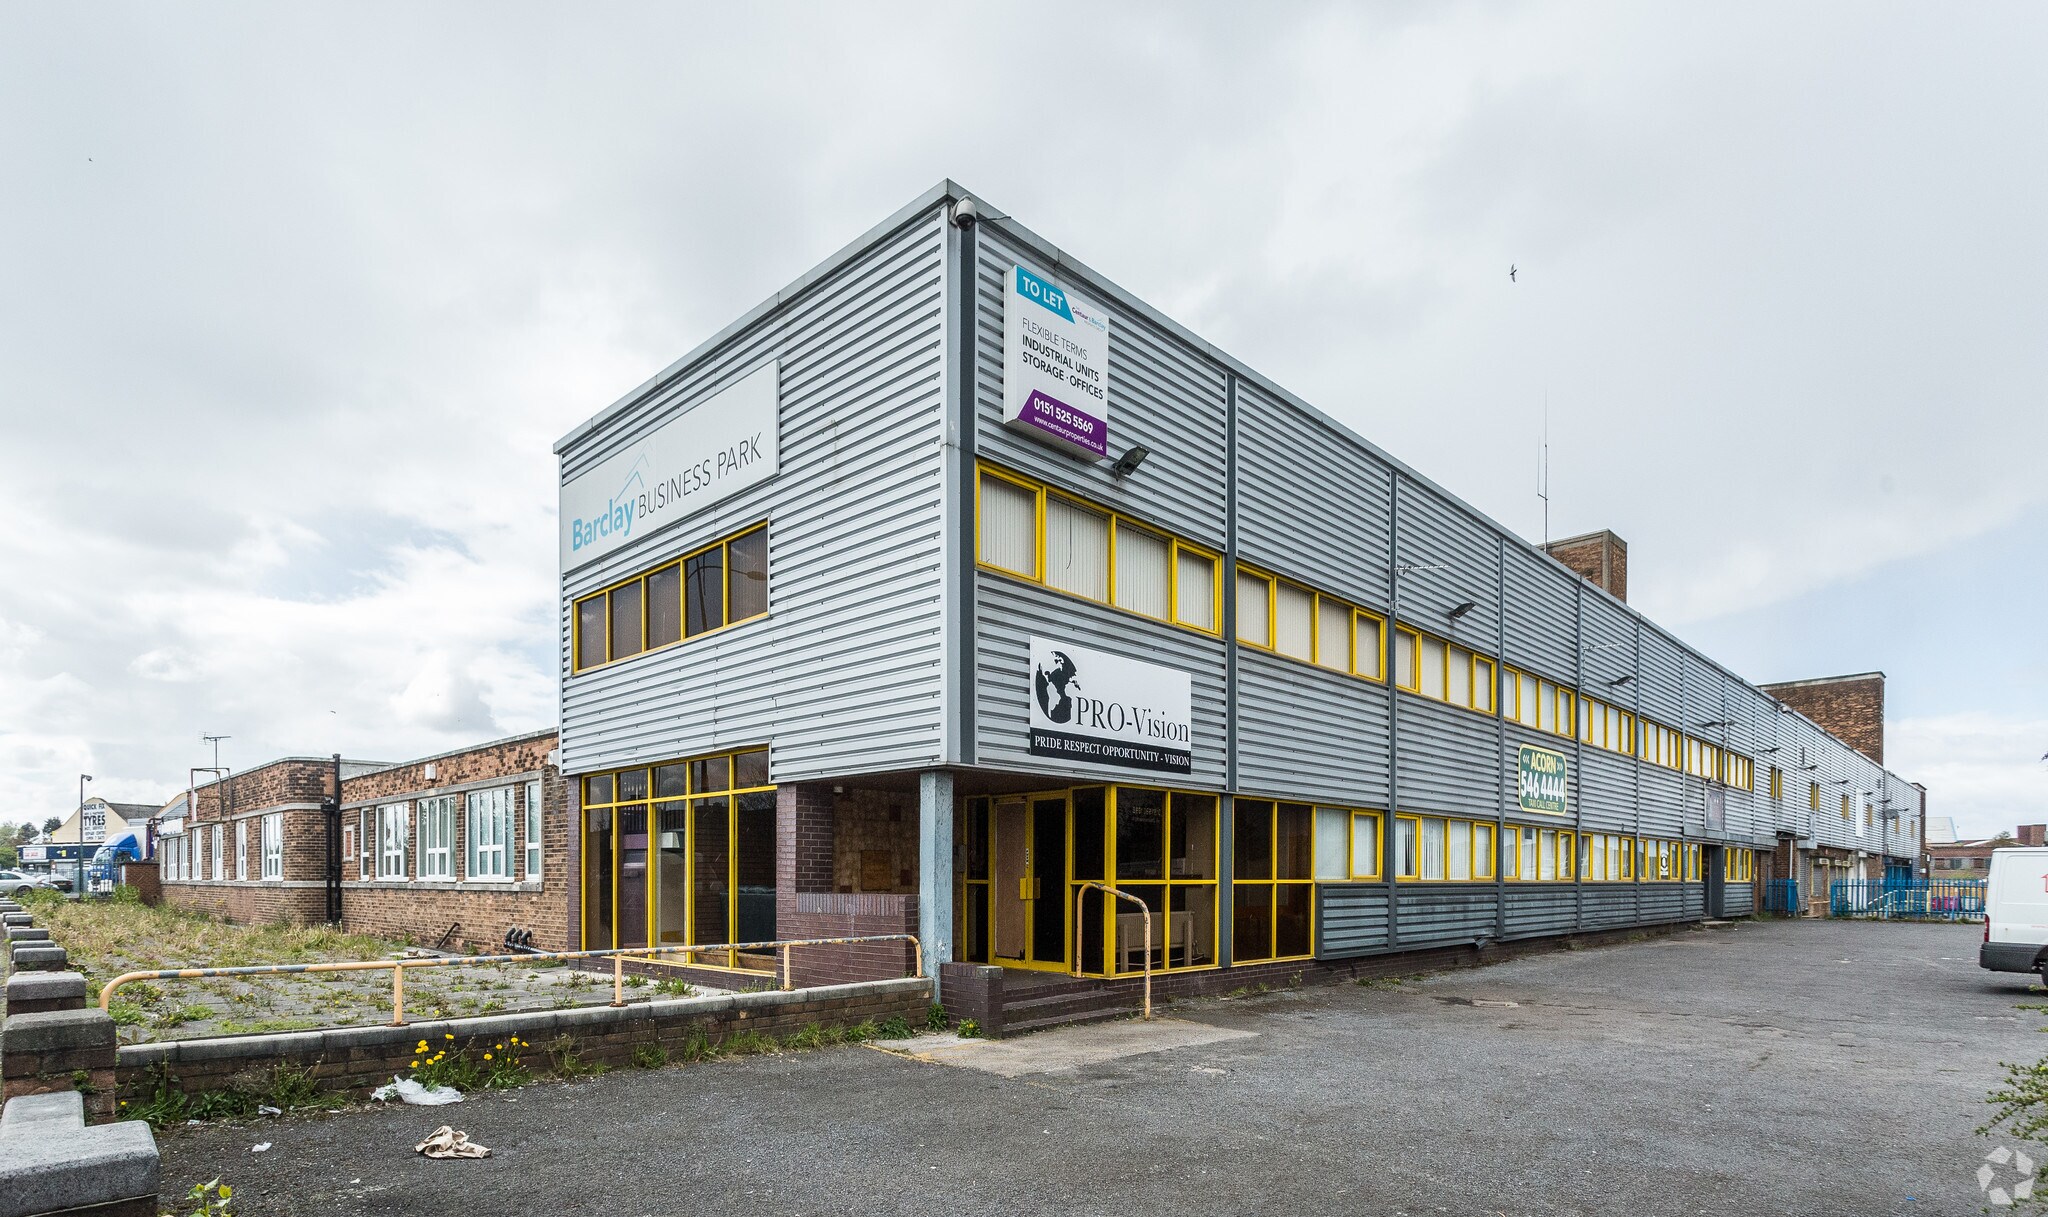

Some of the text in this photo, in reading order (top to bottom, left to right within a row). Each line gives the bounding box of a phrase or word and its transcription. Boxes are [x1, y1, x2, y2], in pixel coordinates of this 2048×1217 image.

[1022, 276, 1063, 310] TO LET
[1022, 317, 1059, 346] FLEXIBLE
[1061, 336, 1088, 361] TERMS
[1022, 334, 1100, 382] INDUSTRIAL UNITS
[1022, 351, 1104, 400] STORAGE OFFICES
[1033, 397, 1094, 434] 0151 525 5569
[1034, 415, 1104, 452] www.centaurproperties.co.uk
[572, 431, 762, 552] Barclay BUSINESS PARK
[1075, 696, 1190, 743] PRO-Vision
[1034, 735, 1190, 766] PRIDE RESPECT OPPORTUNITY VISION
[1530, 751, 1557, 775] ACORN
[1520, 770, 1565, 802] 546 4444
[84, 815, 106, 826] TYRES
[1536, 800, 1546, 809] CALL
[1546, 801, 1559, 811] CENTRE
